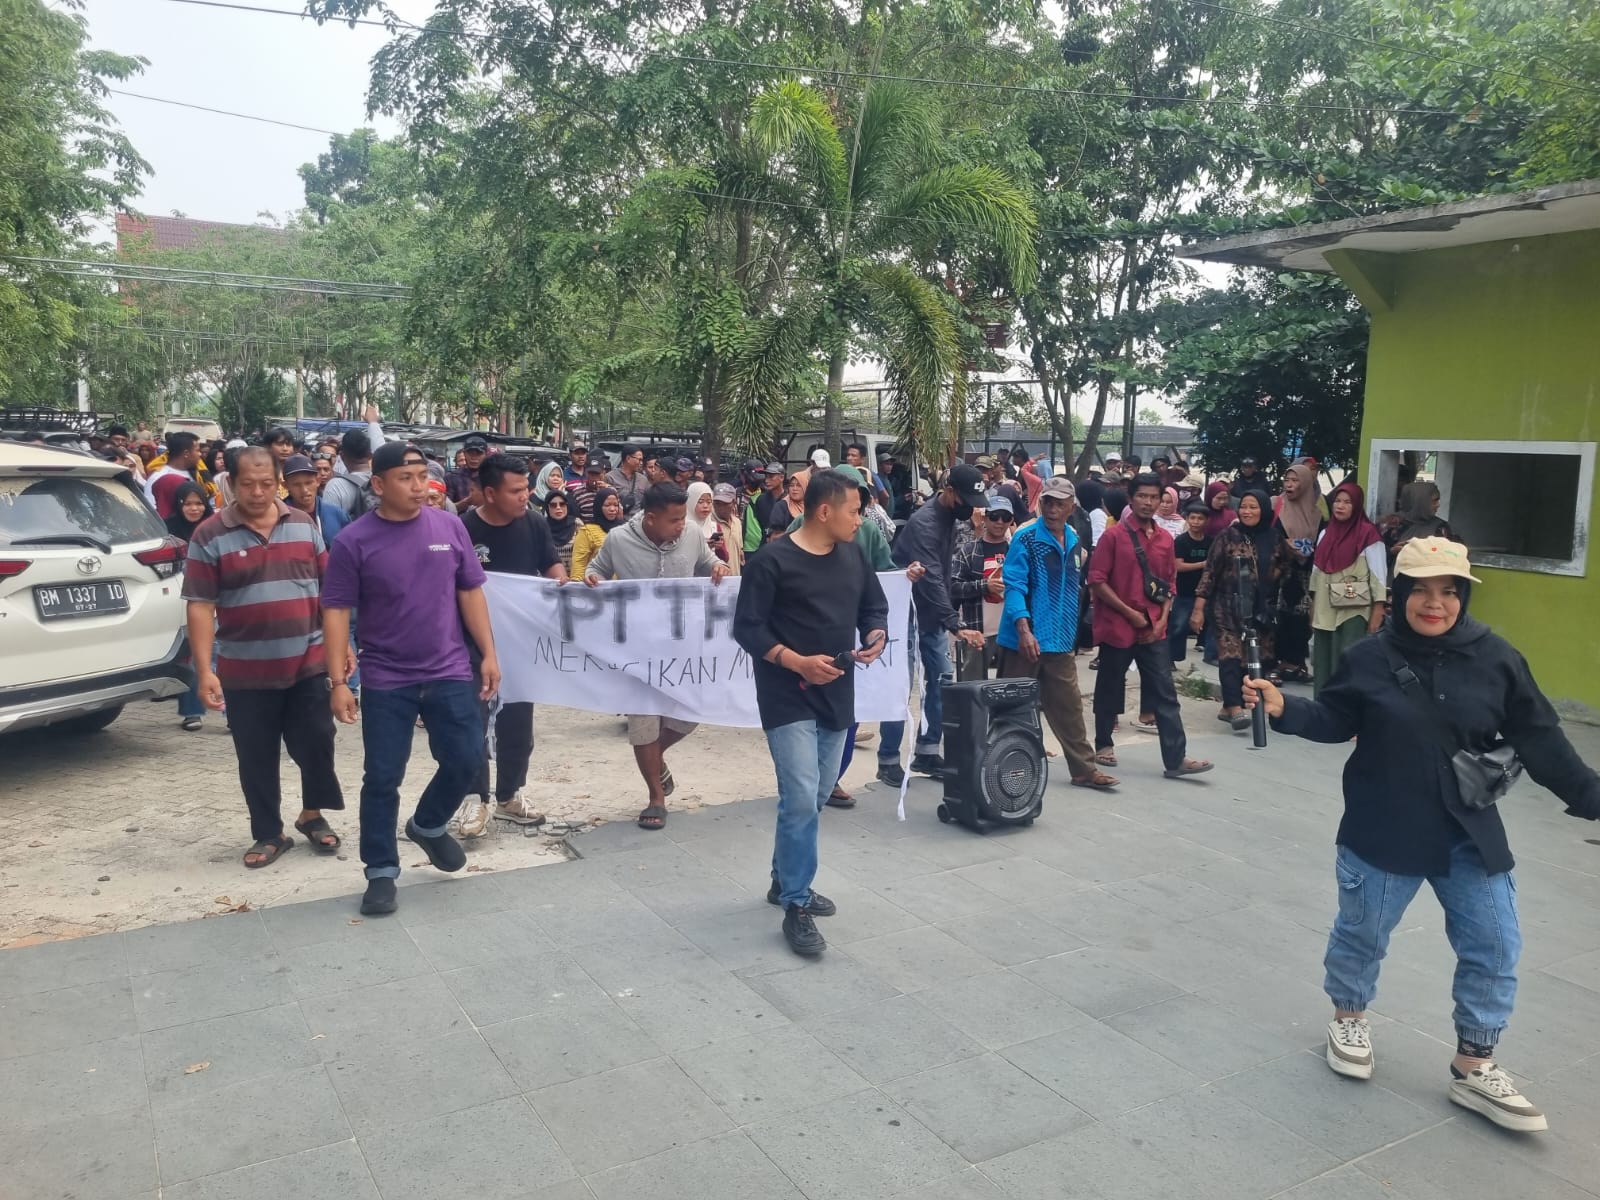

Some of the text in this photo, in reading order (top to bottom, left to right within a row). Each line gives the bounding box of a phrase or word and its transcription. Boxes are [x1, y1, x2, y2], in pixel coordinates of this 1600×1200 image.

[40, 584, 124, 606] BM 1337 ID
[75, 603, 97, 611] 07-27
[541, 583, 640, 644] PT
